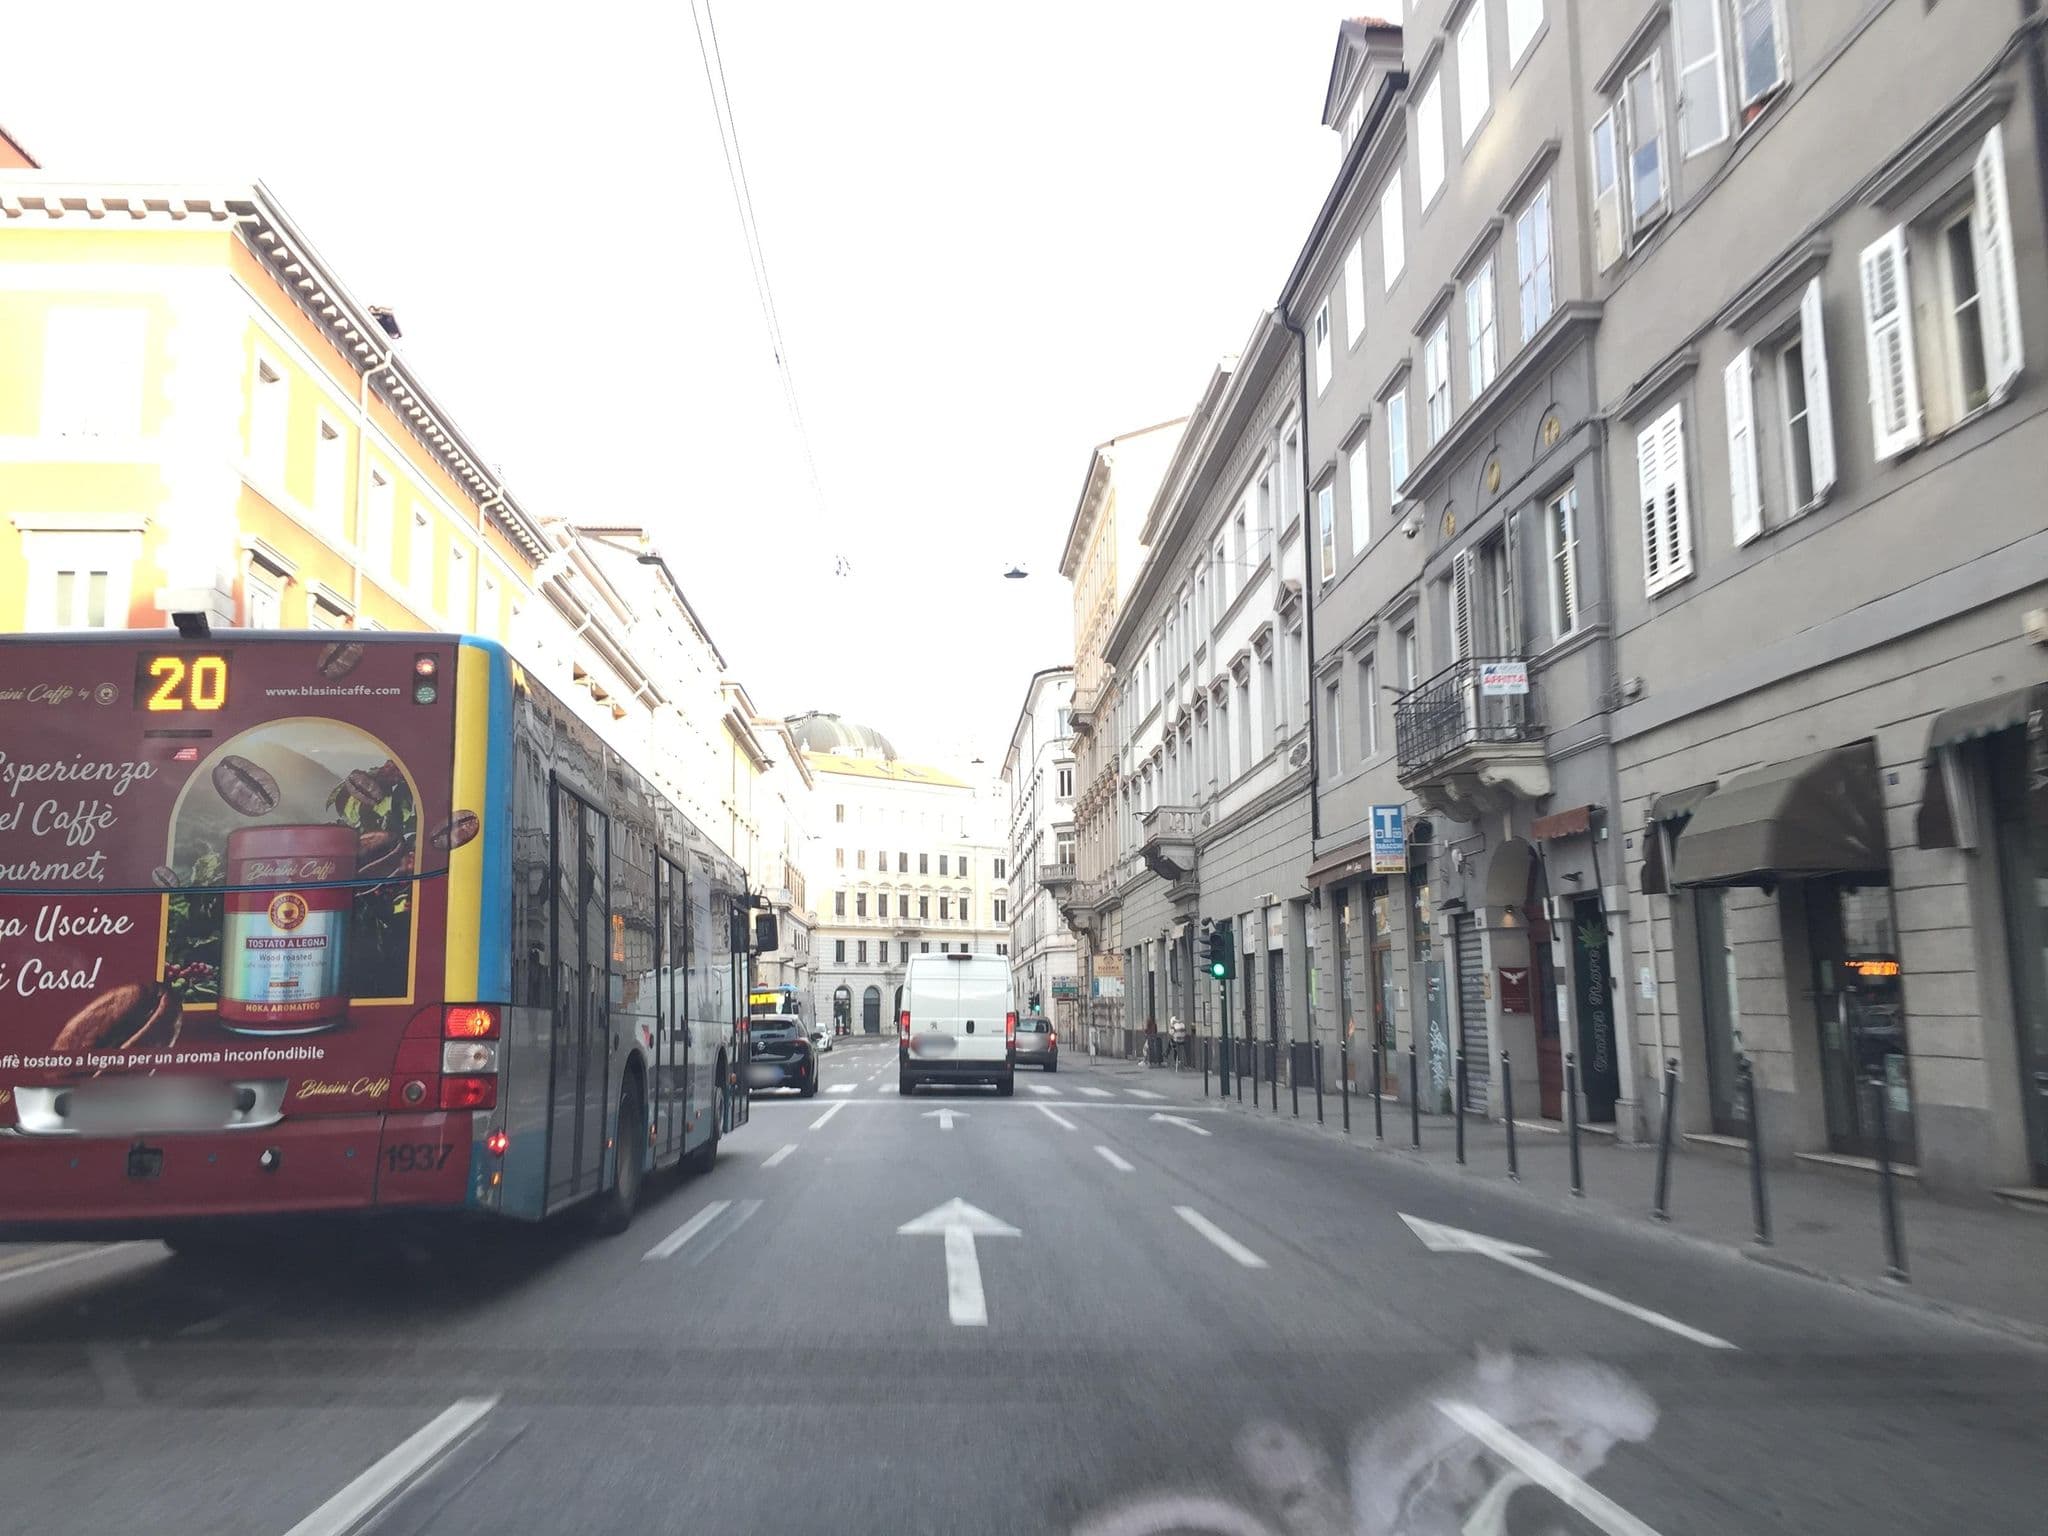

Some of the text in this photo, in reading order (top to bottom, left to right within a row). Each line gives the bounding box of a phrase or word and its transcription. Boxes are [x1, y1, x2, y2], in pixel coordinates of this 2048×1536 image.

[148, 656, 227, 711] 20
[265, 685, 401, 696] www.blasinicaffe.com
[0, 751, 158, 797] sperienza
[31, 799, 118, 846] Caffè
[1376, 808, 1398, 838] T
[34, 905, 135, 942] Uscire
[248, 938, 325, 949] TOSTATO A LEGNA
[16, 956, 103, 997] Casa!
[0, 1046, 325, 1069] ffè tostato a legna per un aroma inconfondibile
[296, 1076, 391, 1099] Blasini Caffè
[385, 1143, 455, 1172] 1937
